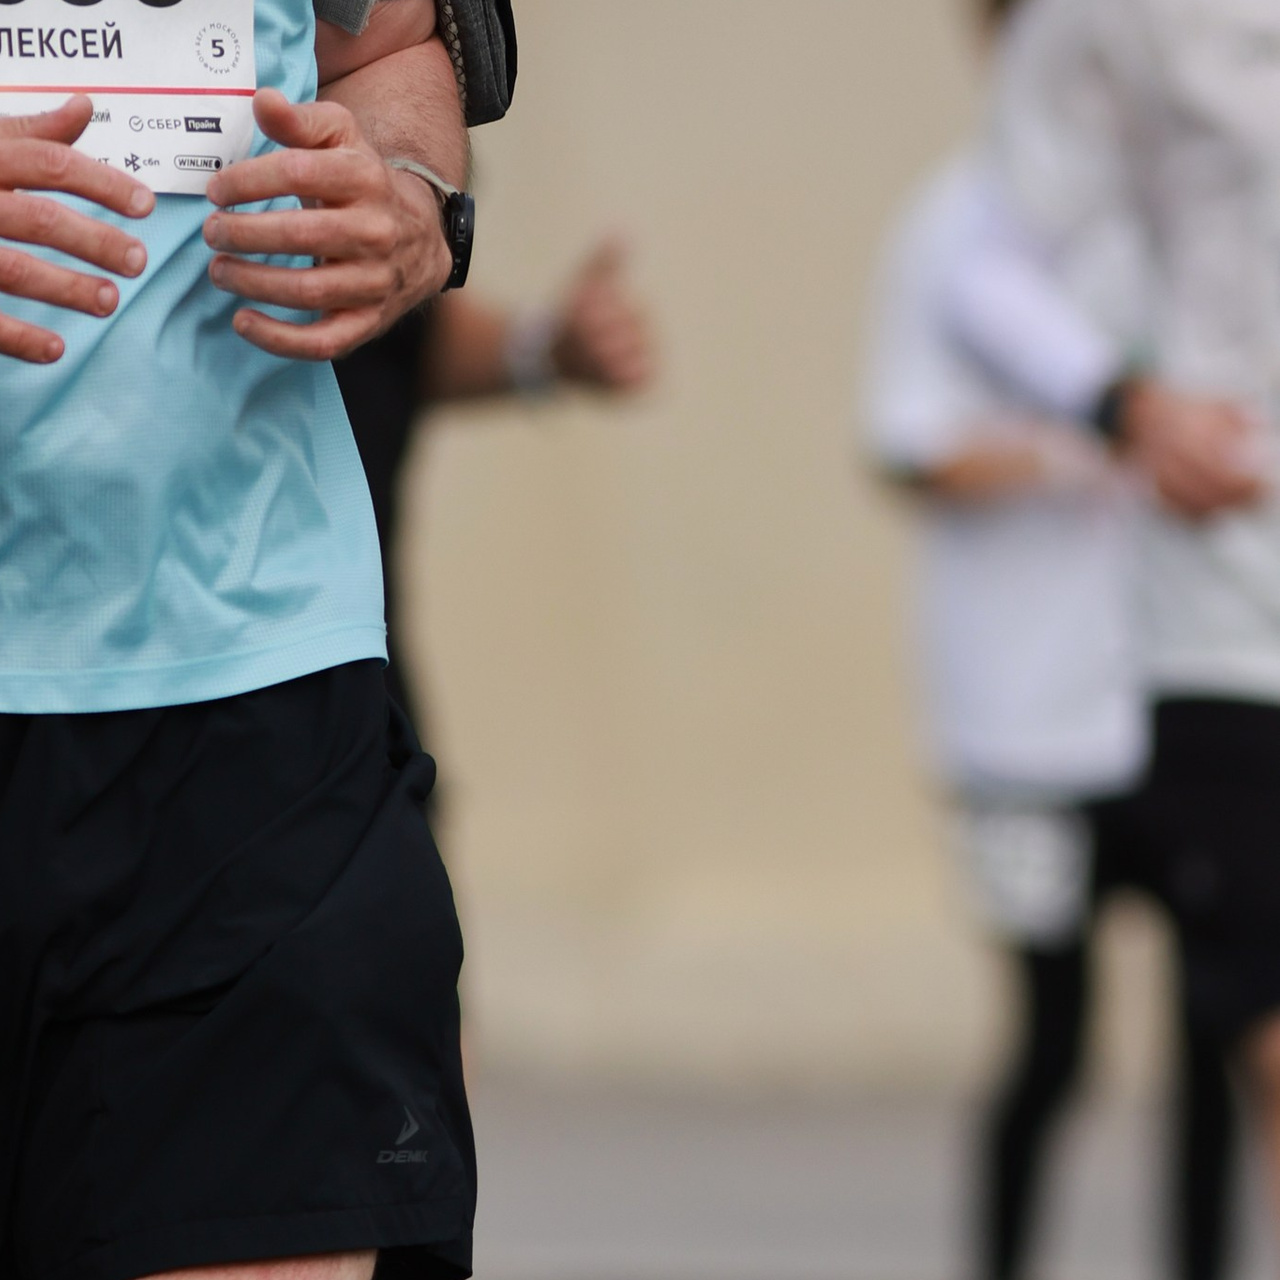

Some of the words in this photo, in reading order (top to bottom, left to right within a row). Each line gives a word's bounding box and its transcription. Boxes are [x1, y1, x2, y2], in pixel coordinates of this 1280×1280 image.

[211, 38, 225, 58] 5
[147, 118, 182, 130] СБЕР
[188, 119, 217, 131] Прайм
[178, 158, 213, 169] WINLINE
